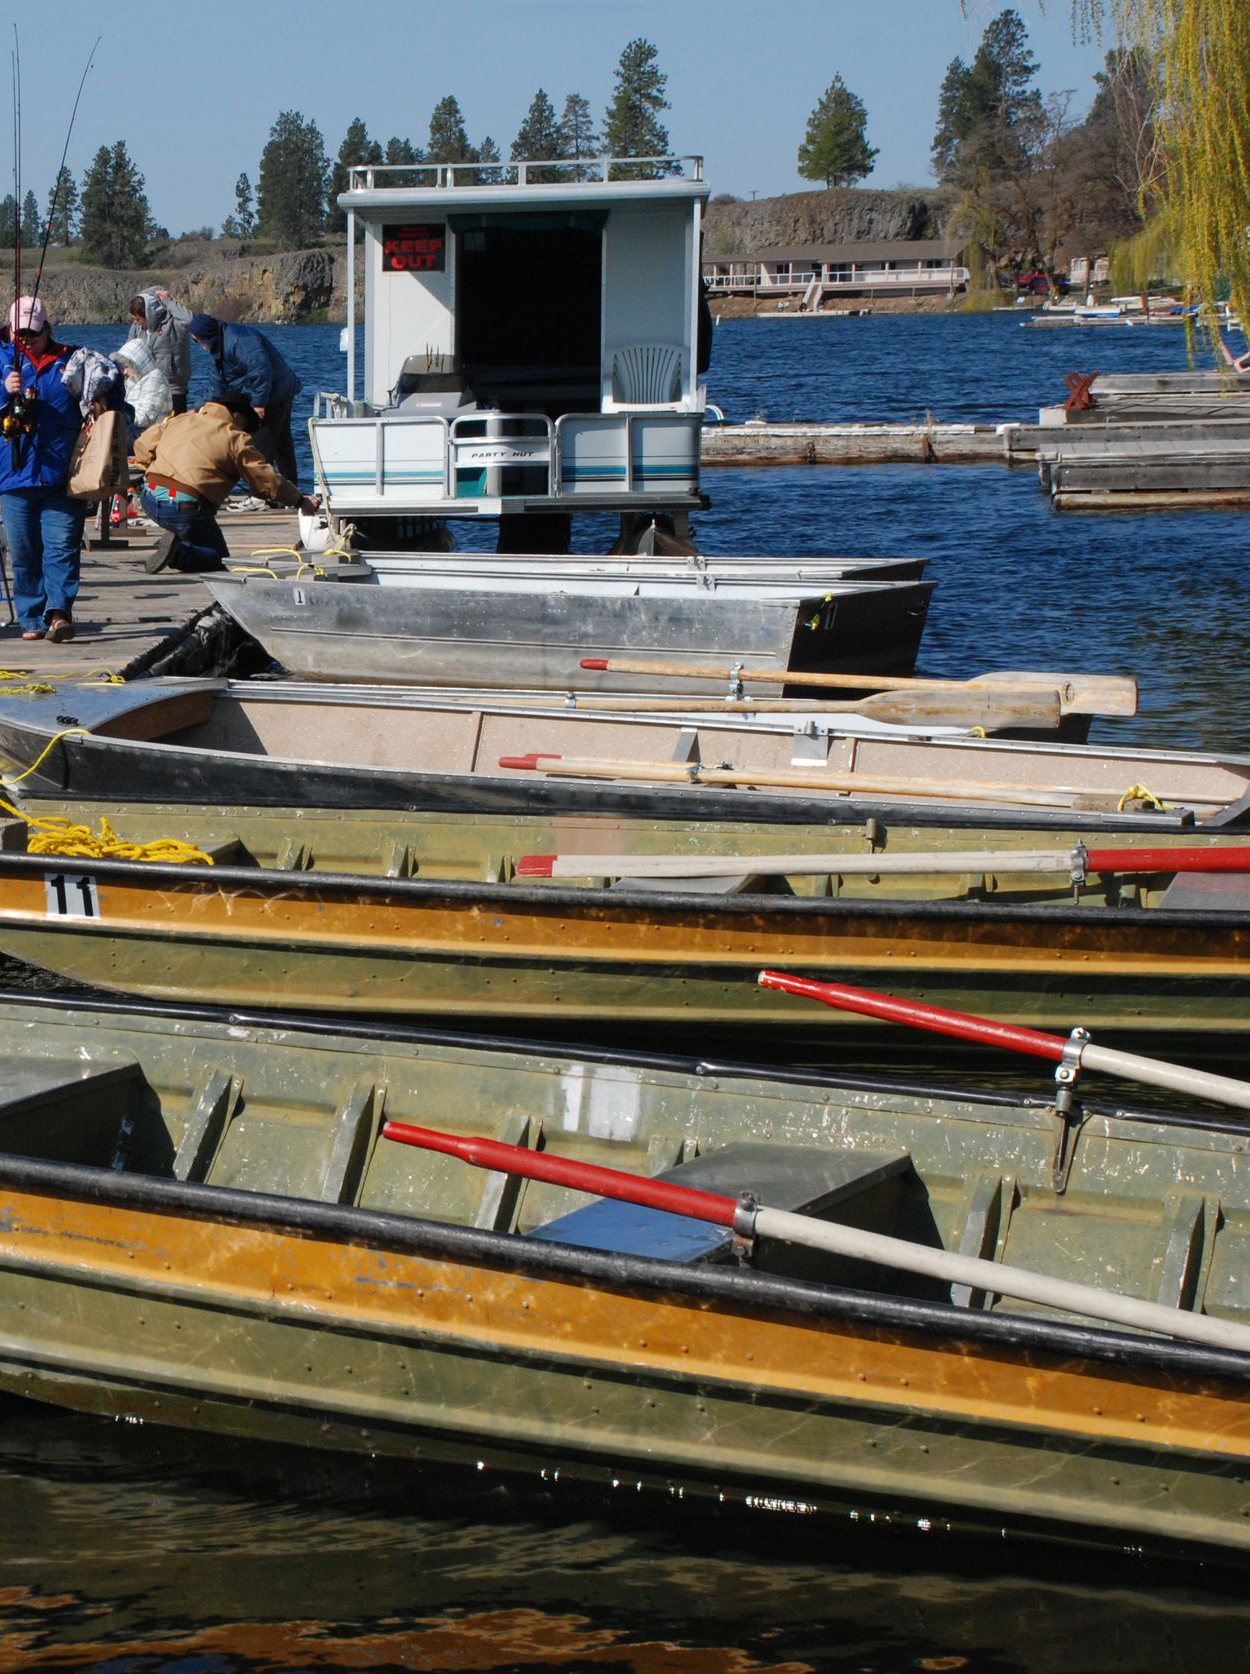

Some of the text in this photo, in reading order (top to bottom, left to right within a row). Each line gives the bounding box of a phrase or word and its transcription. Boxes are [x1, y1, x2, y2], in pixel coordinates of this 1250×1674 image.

[385, 239, 443, 254] KEEP
[391, 255, 436, 269] OUT
[51, 875, 94, 917] 11
